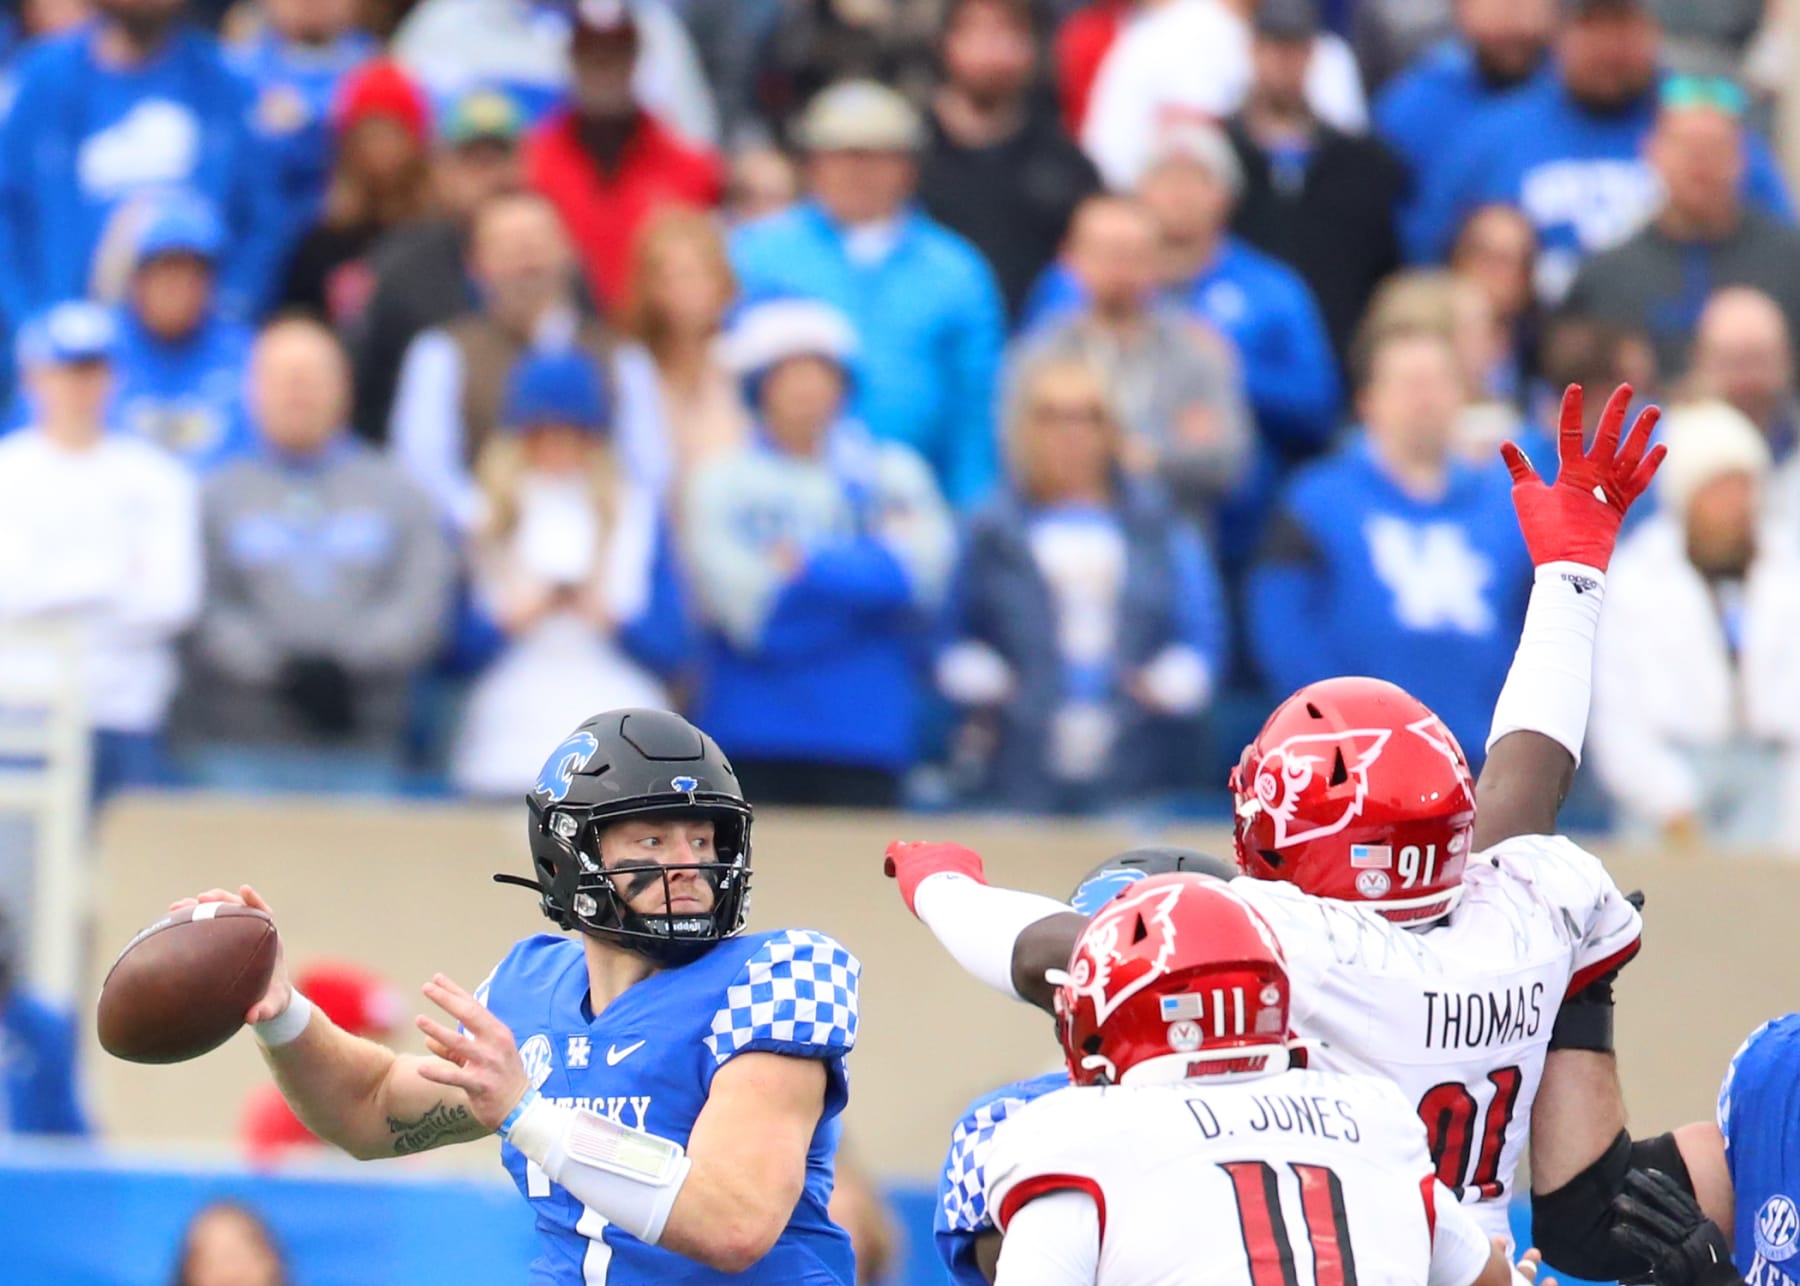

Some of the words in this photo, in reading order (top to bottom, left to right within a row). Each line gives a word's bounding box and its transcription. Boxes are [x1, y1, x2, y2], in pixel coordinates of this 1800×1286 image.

[1397, 844, 1436, 889] 91
[1211, 986, 1246, 1038] 11
[1423, 982, 1544, 1049] THOMAS
[1185, 1098, 1235, 1139] D.
[1250, 1095, 1361, 1143] JONES
[1759, 1198, 1796, 1247] SEC
